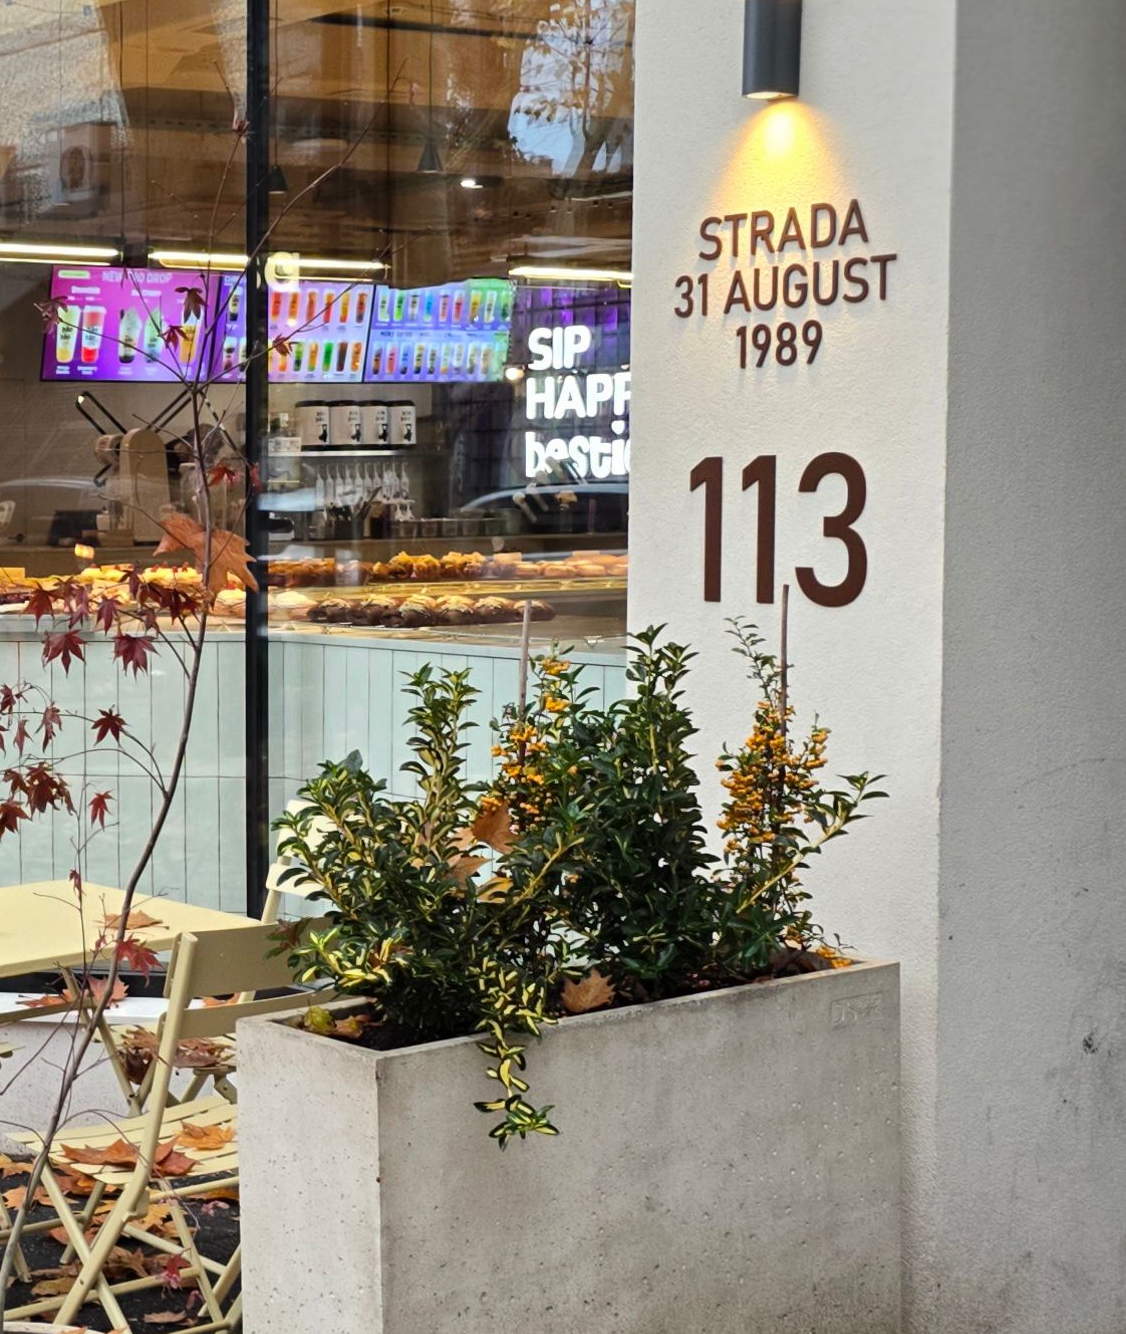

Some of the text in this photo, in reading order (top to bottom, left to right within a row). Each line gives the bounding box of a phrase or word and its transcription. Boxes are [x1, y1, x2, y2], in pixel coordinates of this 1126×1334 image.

[698, 199, 869, 262] STRADA
[674, 253, 898, 318] 31 AUGUST
[528, 325, 592, 371] SIP
[736, 319, 823, 369] 1989
[689, 451, 868, 608] 113
